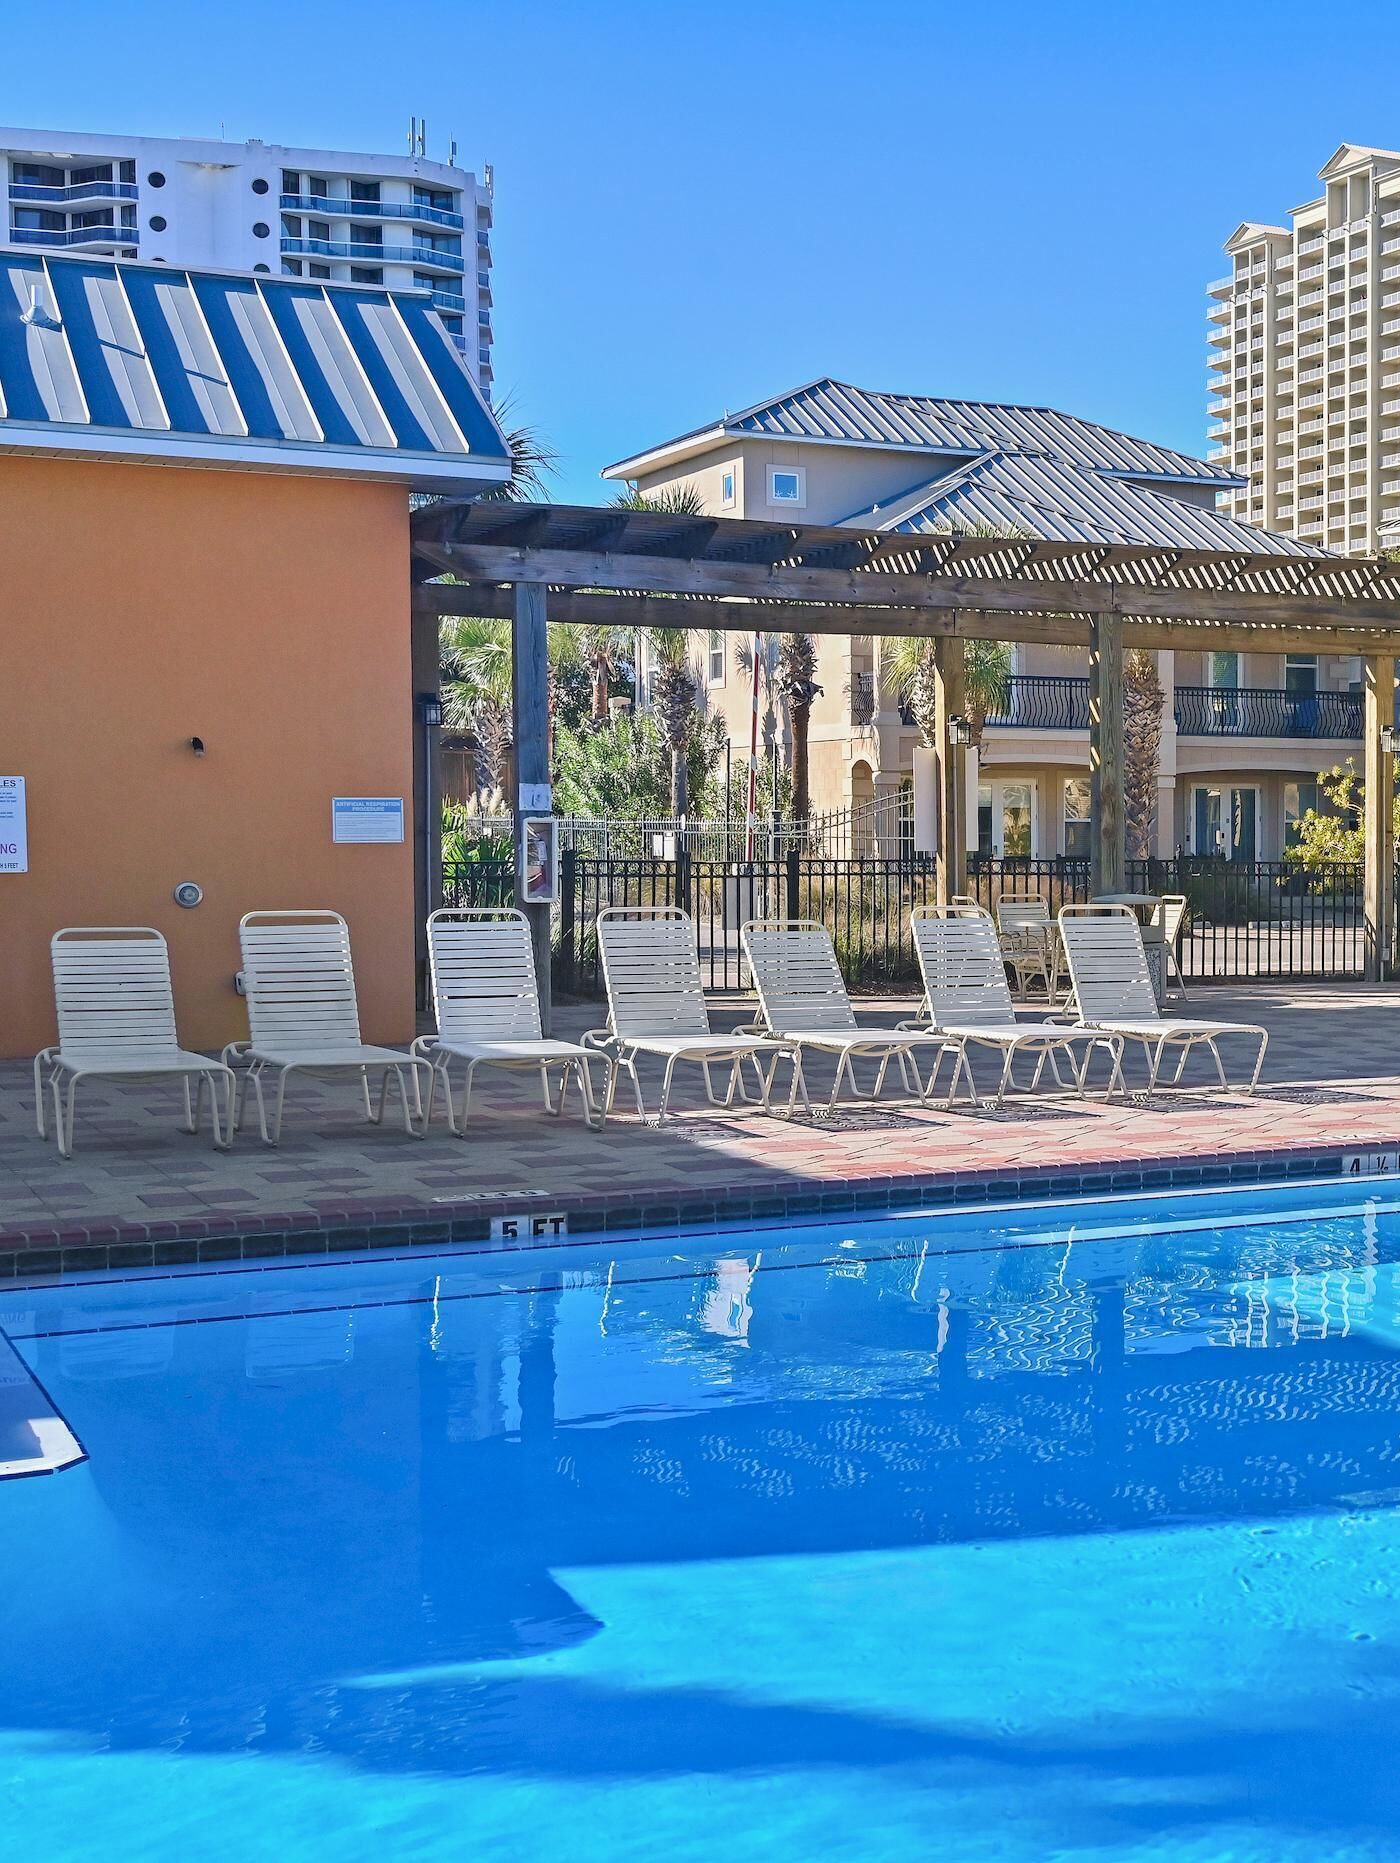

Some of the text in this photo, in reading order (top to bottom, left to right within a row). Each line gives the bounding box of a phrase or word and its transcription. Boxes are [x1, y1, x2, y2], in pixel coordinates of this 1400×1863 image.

[1350, 1157, 1361, 1173] 4
[502, 1217, 565, 1238] 5 FT
